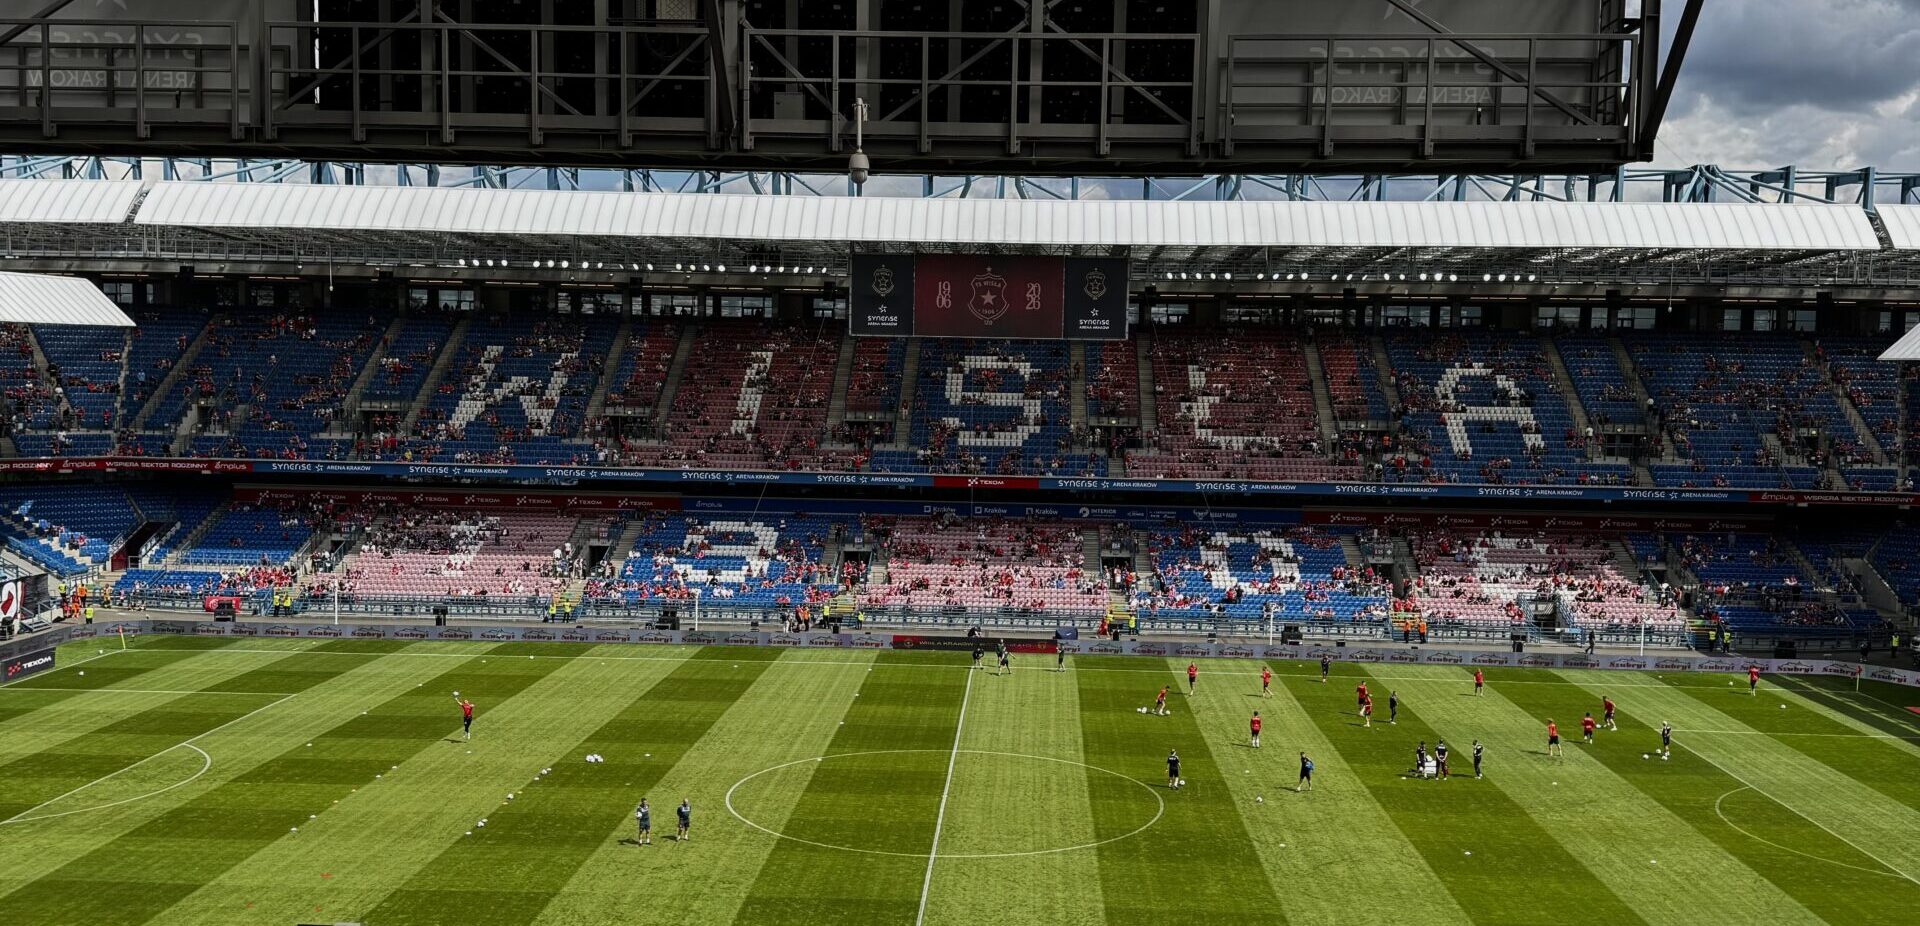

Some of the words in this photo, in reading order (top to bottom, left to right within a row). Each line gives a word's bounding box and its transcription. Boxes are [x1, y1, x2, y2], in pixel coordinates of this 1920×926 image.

[937, 281, 951, 296] 19
[1026, 282, 1041, 297] 20
[936, 295, 952, 309] 06
[1026, 295, 1041, 310] 26
[22, 655, 52, 669] TEXOM
